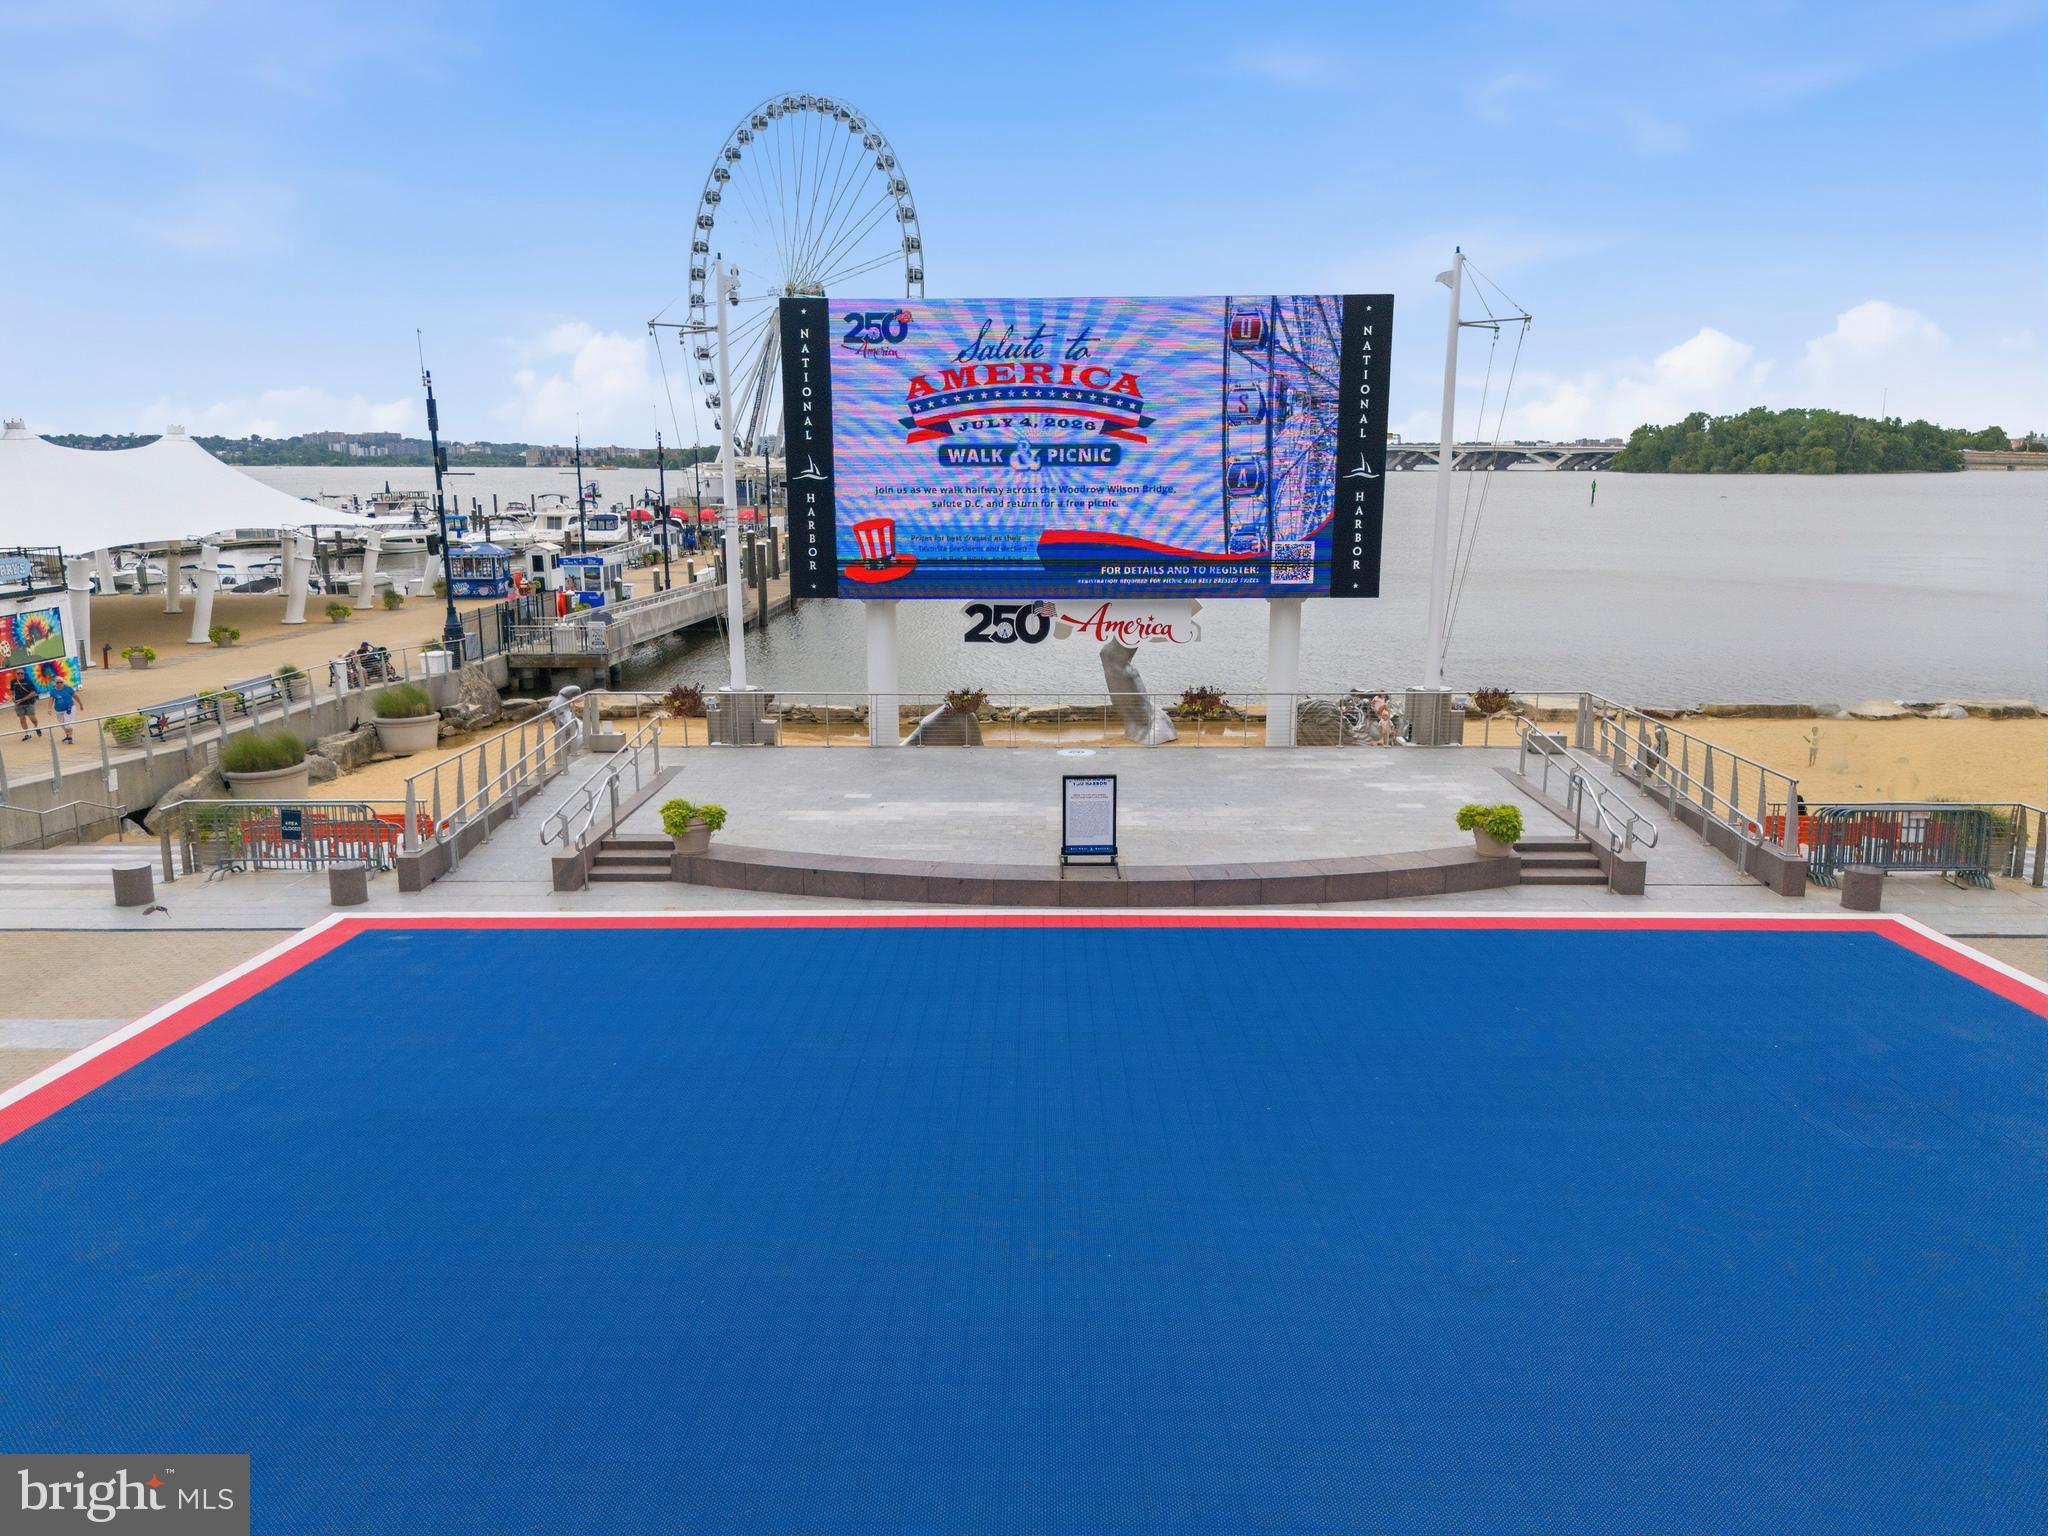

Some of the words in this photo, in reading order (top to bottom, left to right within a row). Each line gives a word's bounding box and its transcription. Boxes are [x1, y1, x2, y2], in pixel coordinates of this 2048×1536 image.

[843, 311, 909, 345] 250
[952, 318, 1056, 363] Salute
[1066, 326, 1101, 361] to
[906, 362, 1144, 400] AMERICA
[1359, 325, 1373, 439] NATIONAL
[958, 418, 1013, 432] JULY
[1019, 417, 1038, 430] 4,
[1044, 417, 1096, 431] 2026
[800, 328, 812, 441] NATIONAL
[806, 493, 818, 571] HARBOR
[947, 447, 1003, 464] WALK
[1009, 437, 1042, 471] &
[1047, 447, 1112, 464] PICNIC
[875, 486, 894, 496] Join
[940, 486, 963, 494] walk
[965, 486, 1004, 496] halfway
[1040, 486, 1056, 494] the
[1058, 485, 1105, 494] Woodrow
[1107, 485, 1140, 494] Wilson
[931, 500, 962, 508] salute
[964, 500, 983, 508] D.C.
[986, 499, 1004, 508] and
[1006, 500, 1038, 508] return
[1041, 499, 1055, 508] for
[1066, 499, 1085, 508] free
[1353, 491, 1365, 570] HARBOR
[1101, 566, 1121, 575] FOR
[1123, 566, 1165, 575] DETAILS
[1167, 566, 1190, 575] AND
[1193, 566, 1207, 574] TO
[964, 603, 1051, 644] 250
[1060, 602, 1194, 646] America
